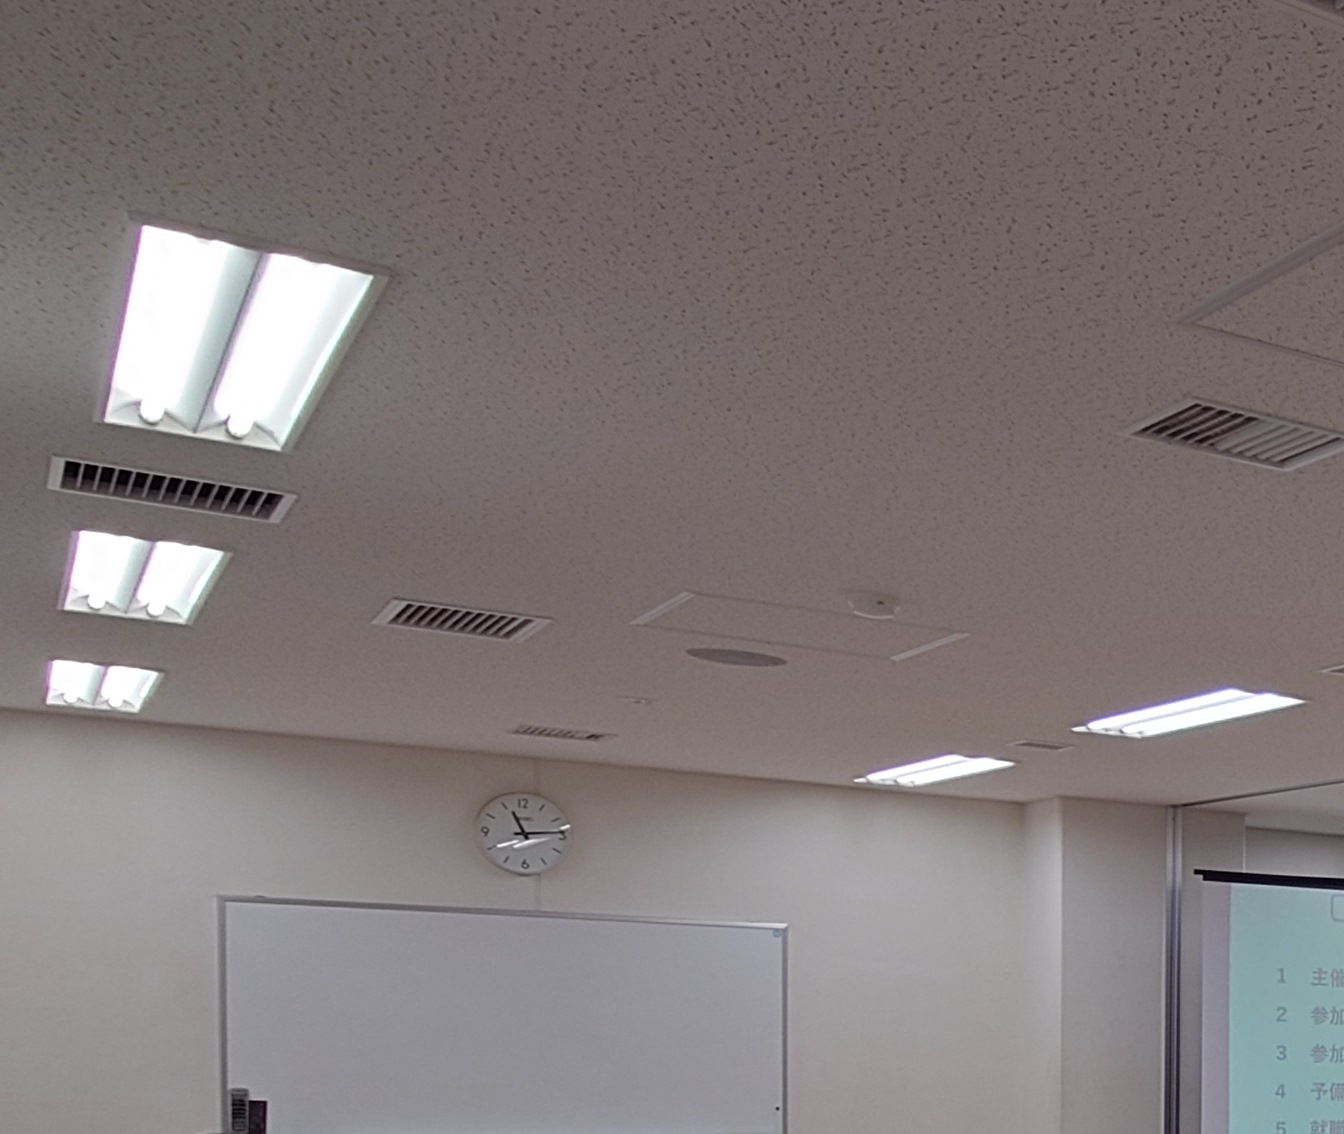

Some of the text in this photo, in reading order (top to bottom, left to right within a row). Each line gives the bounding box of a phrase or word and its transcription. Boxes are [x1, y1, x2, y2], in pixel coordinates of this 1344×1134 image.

[517, 798, 529, 809] 12
[480, 826, 490, 837] 9
[521, 858, 530, 869] 6
[1276, 968, 1287, 984] 1
[1276, 1006, 1288, 1022] 2
[1276, 1045, 1287, 1061] 3
[1275, 1084, 1286, 1099] 4
